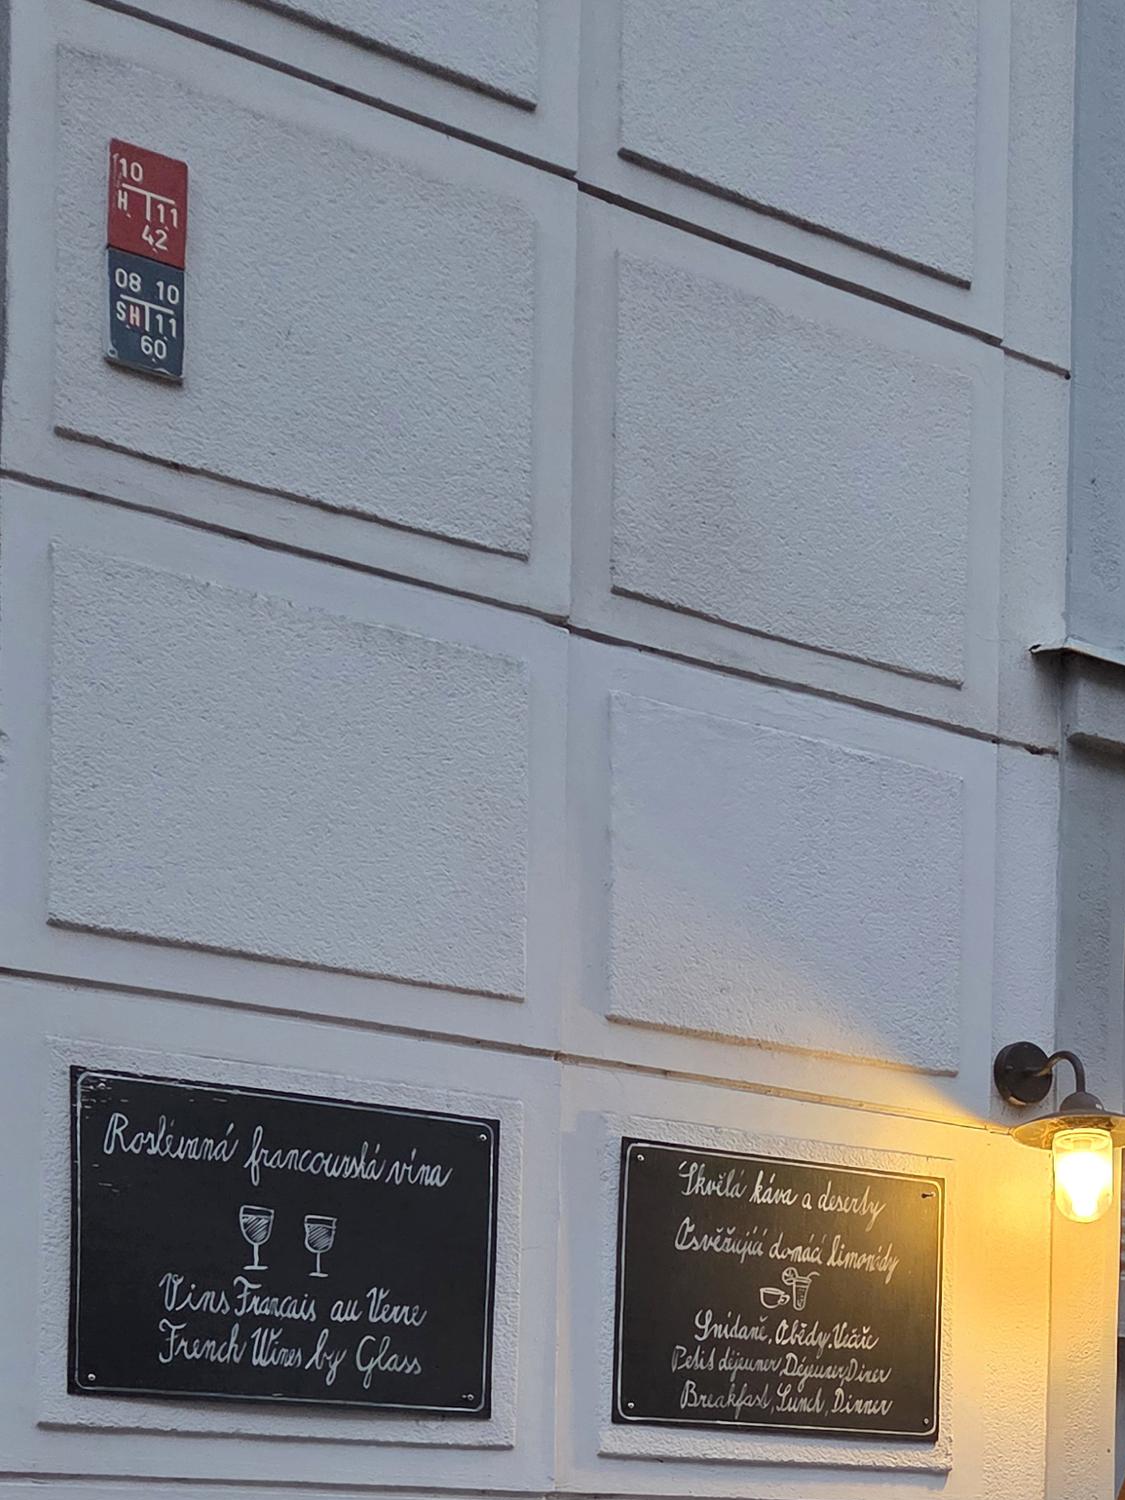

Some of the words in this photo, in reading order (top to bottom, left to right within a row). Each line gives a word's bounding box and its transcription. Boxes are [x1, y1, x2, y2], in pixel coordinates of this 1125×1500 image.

[118, 157, 145, 184] 10
[115, 267, 143, 295] 08
[155, 279, 181, 306] 10
[384, 1149, 454, 1188] vína
[748, 1169, 799, 1206] káva
[801, 1188, 813, 1210] a
[158, 1272, 231, 1315] Vins
[330, 1298, 363, 1323] au
[366, 1287, 429, 1328] Verre
[159, 1319, 247, 1364] French
[250, 1327, 303, 1368] Wines
[304, 1328, 348, 1387] by
[356, 1335, 423, 1389] Glass
[831, 1387, 893, 1416] Dinner
